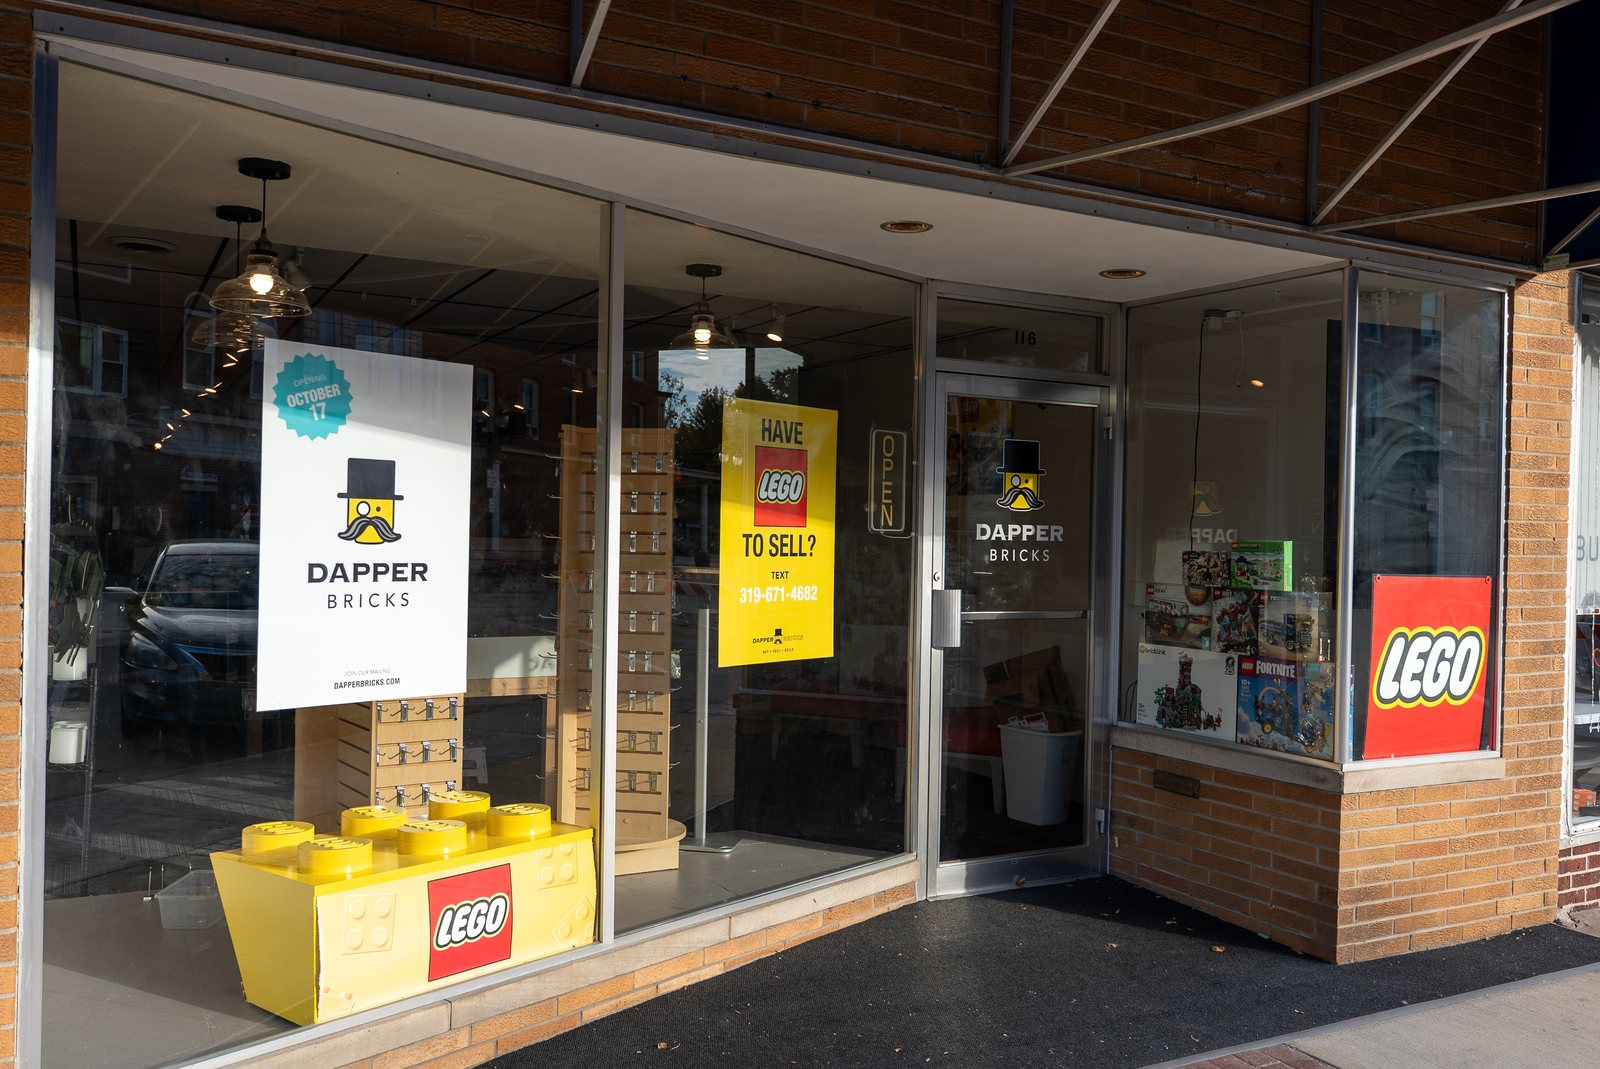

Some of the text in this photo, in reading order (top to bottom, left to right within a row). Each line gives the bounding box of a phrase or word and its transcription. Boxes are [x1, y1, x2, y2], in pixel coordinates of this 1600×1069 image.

[1015, 330, 1037, 346] 116
[293, 373, 327, 387] OPENING
[287, 384, 342, 408] OCTOBER
[308, 401, 326, 421] 17
[761, 418, 803, 445] HAVE
[757, 470, 805, 503] LEGO
[881, 435, 894, 527] OPEN
[975, 523, 1064, 542] DAPPER
[742, 533, 817, 558] TO SELL?
[989, 549, 1051, 562] BRICKS
[307, 562, 428, 583] DAPPER
[771, 571, 789, 580] TEXT
[327, 592, 410, 609] BRICKS
[739, 585, 818, 604] 319-671-4682
[1224, 666, 1235, 676] 25
[1256, 660, 1296, 678] FORTNITE
[1374, 629, 1484, 705] LEGO
[333, 678, 400, 689] DAPPERBRICKS.COM
[435, 894, 509, 949] LEGO
